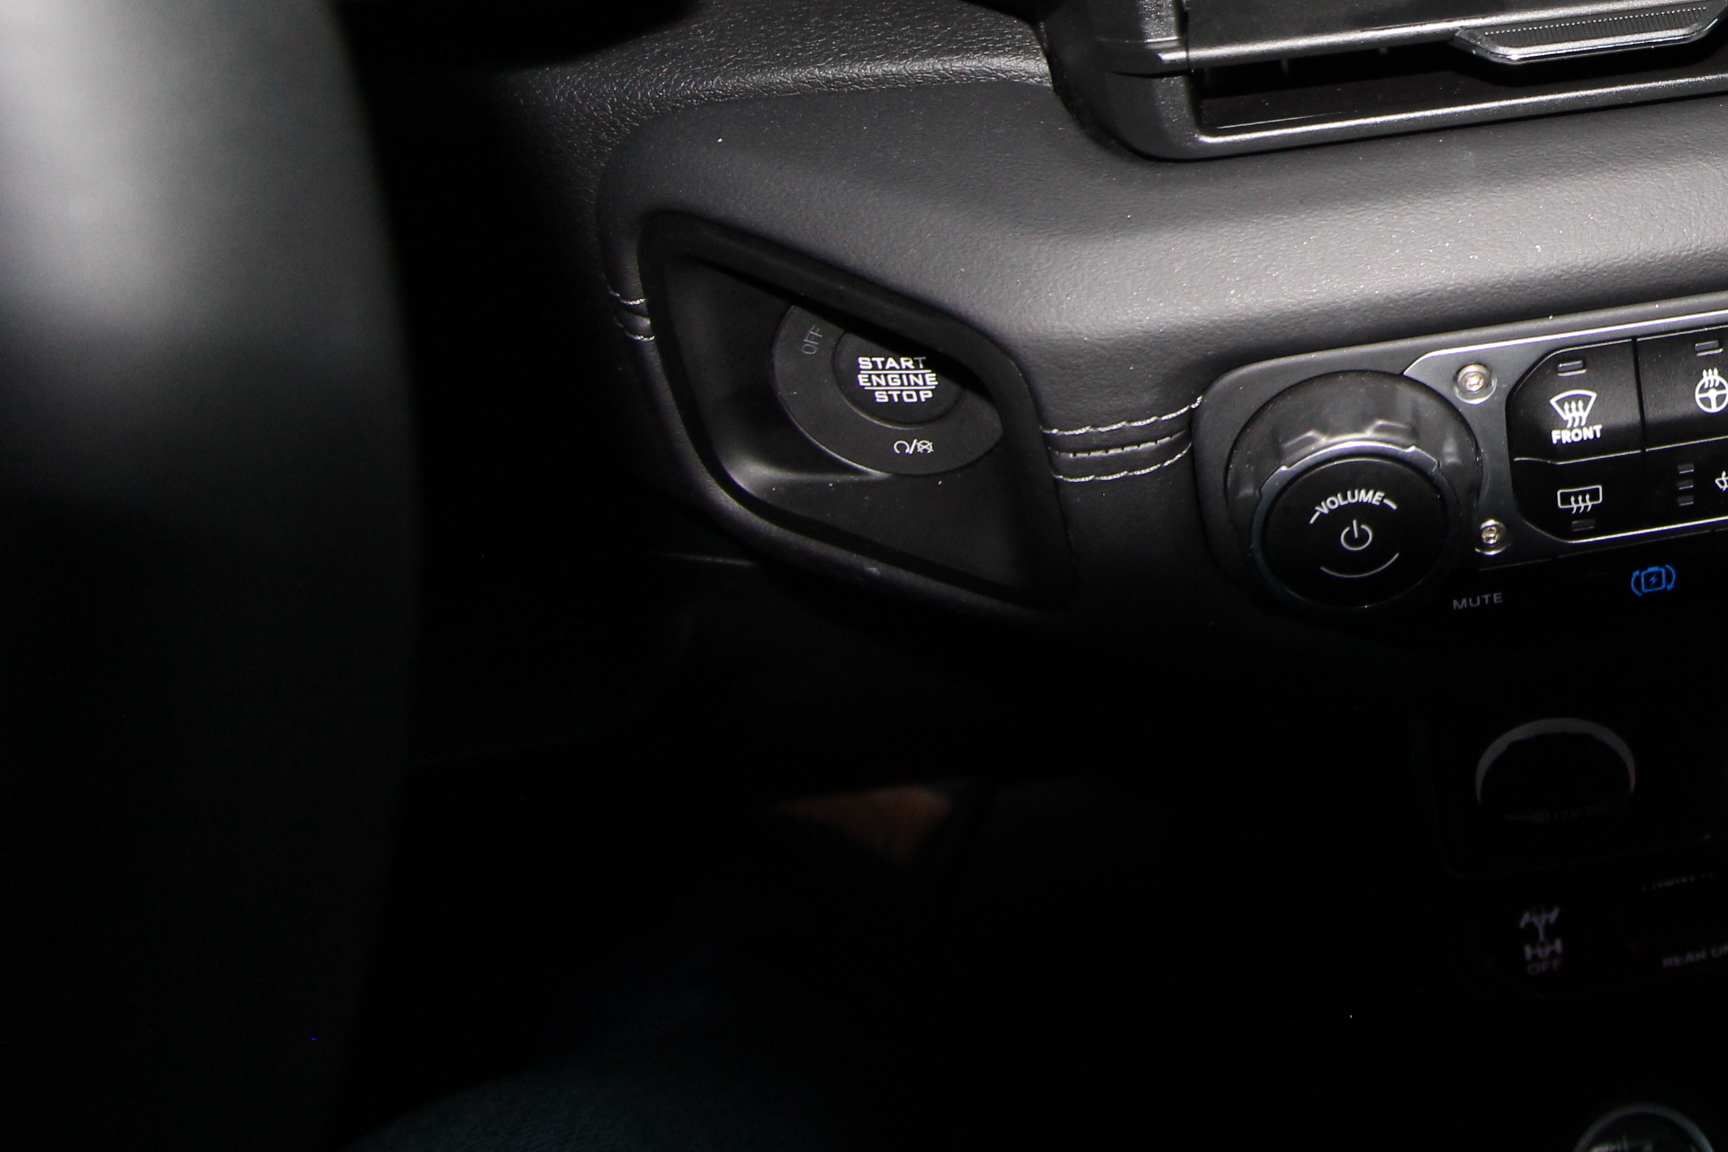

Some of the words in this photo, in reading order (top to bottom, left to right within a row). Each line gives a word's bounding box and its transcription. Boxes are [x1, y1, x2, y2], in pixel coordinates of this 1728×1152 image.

[800, 325, 824, 356] OFF
[857, 356, 927, 370] START
[856, 373, 939, 387] ENGINE
[874, 390, 934, 404] STOP
[1550, 424, 1603, 445] FRONT
[1314, 489, 1385, 517] VOLUME
[1452, 592, 1505, 612] MUTE
